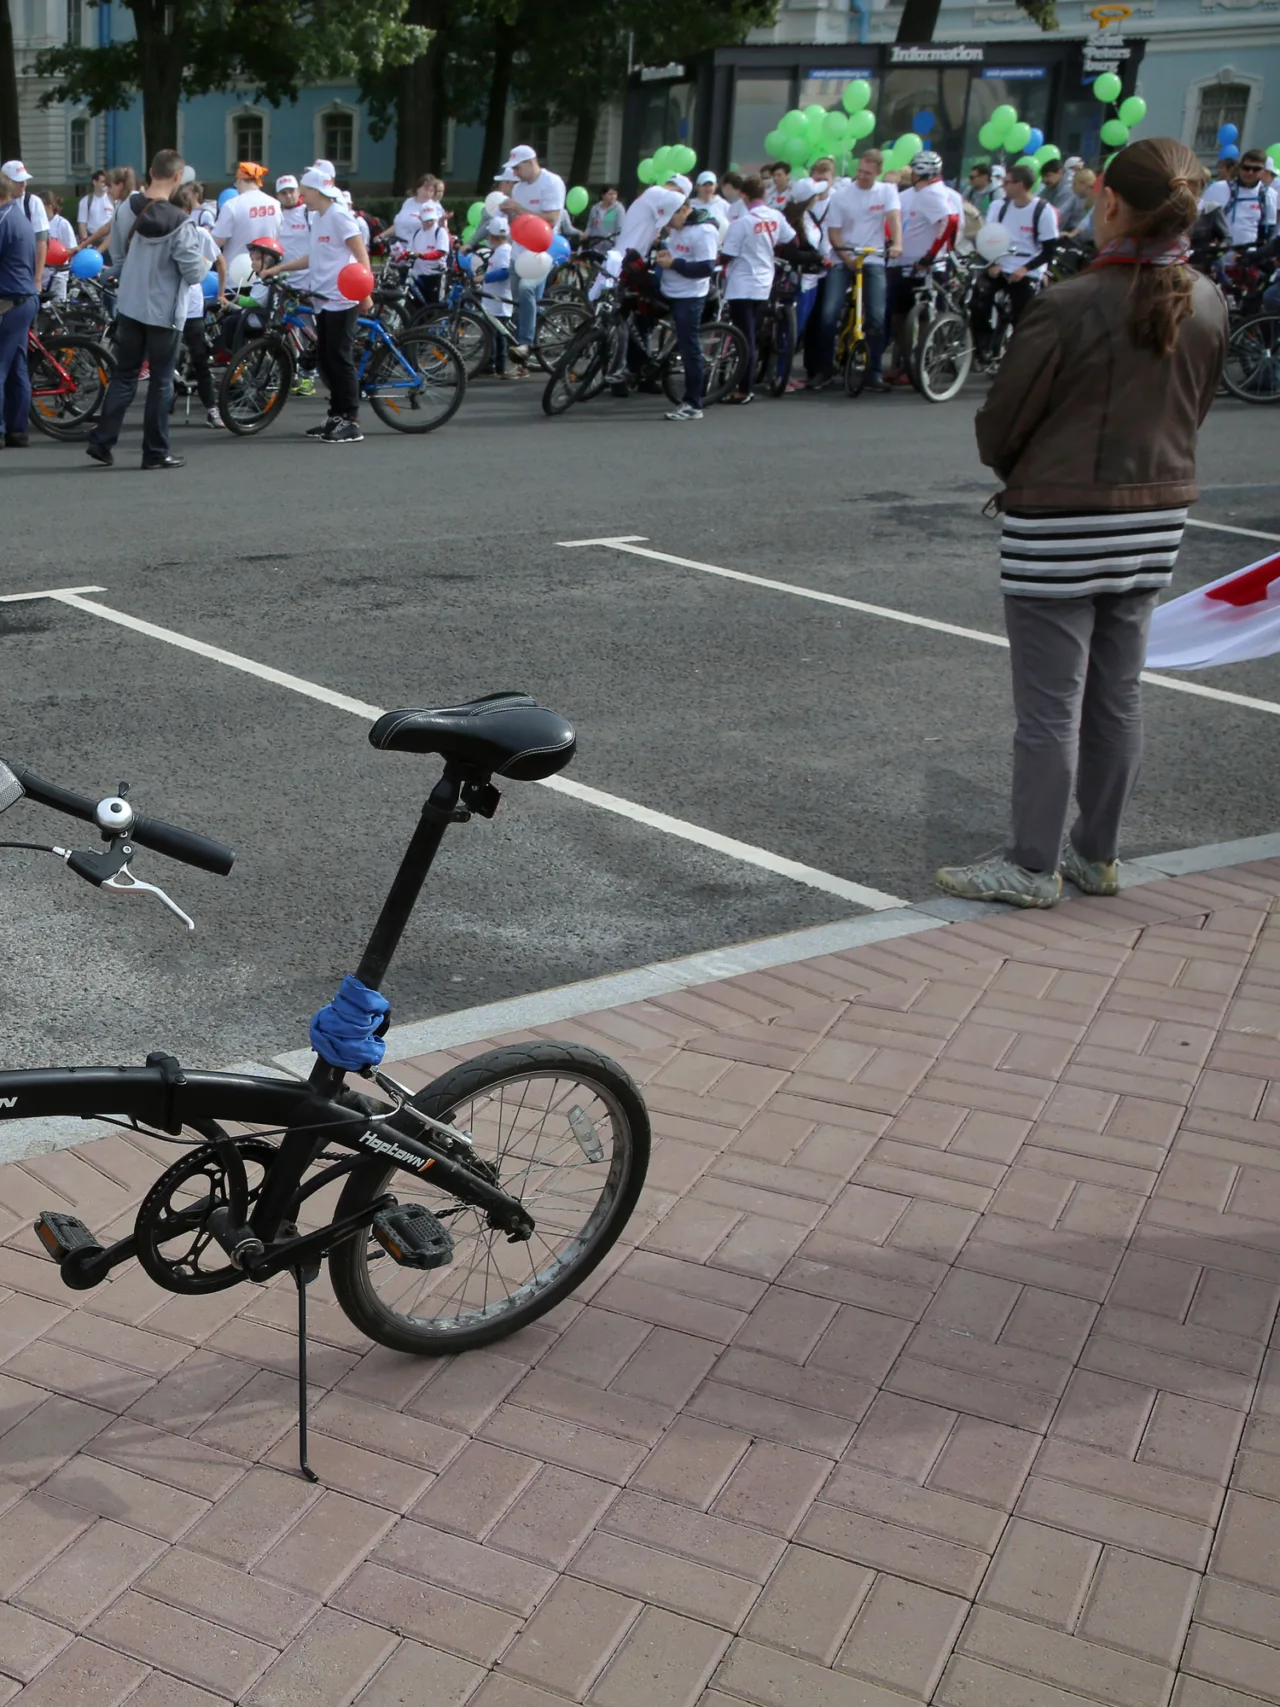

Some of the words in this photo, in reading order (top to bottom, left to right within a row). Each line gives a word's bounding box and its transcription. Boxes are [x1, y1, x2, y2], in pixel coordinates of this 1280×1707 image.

[890, 45, 984, 62] Information
[1082, 46, 1131, 59] Peters
[358, 1130, 426, 1168] Hoptown
